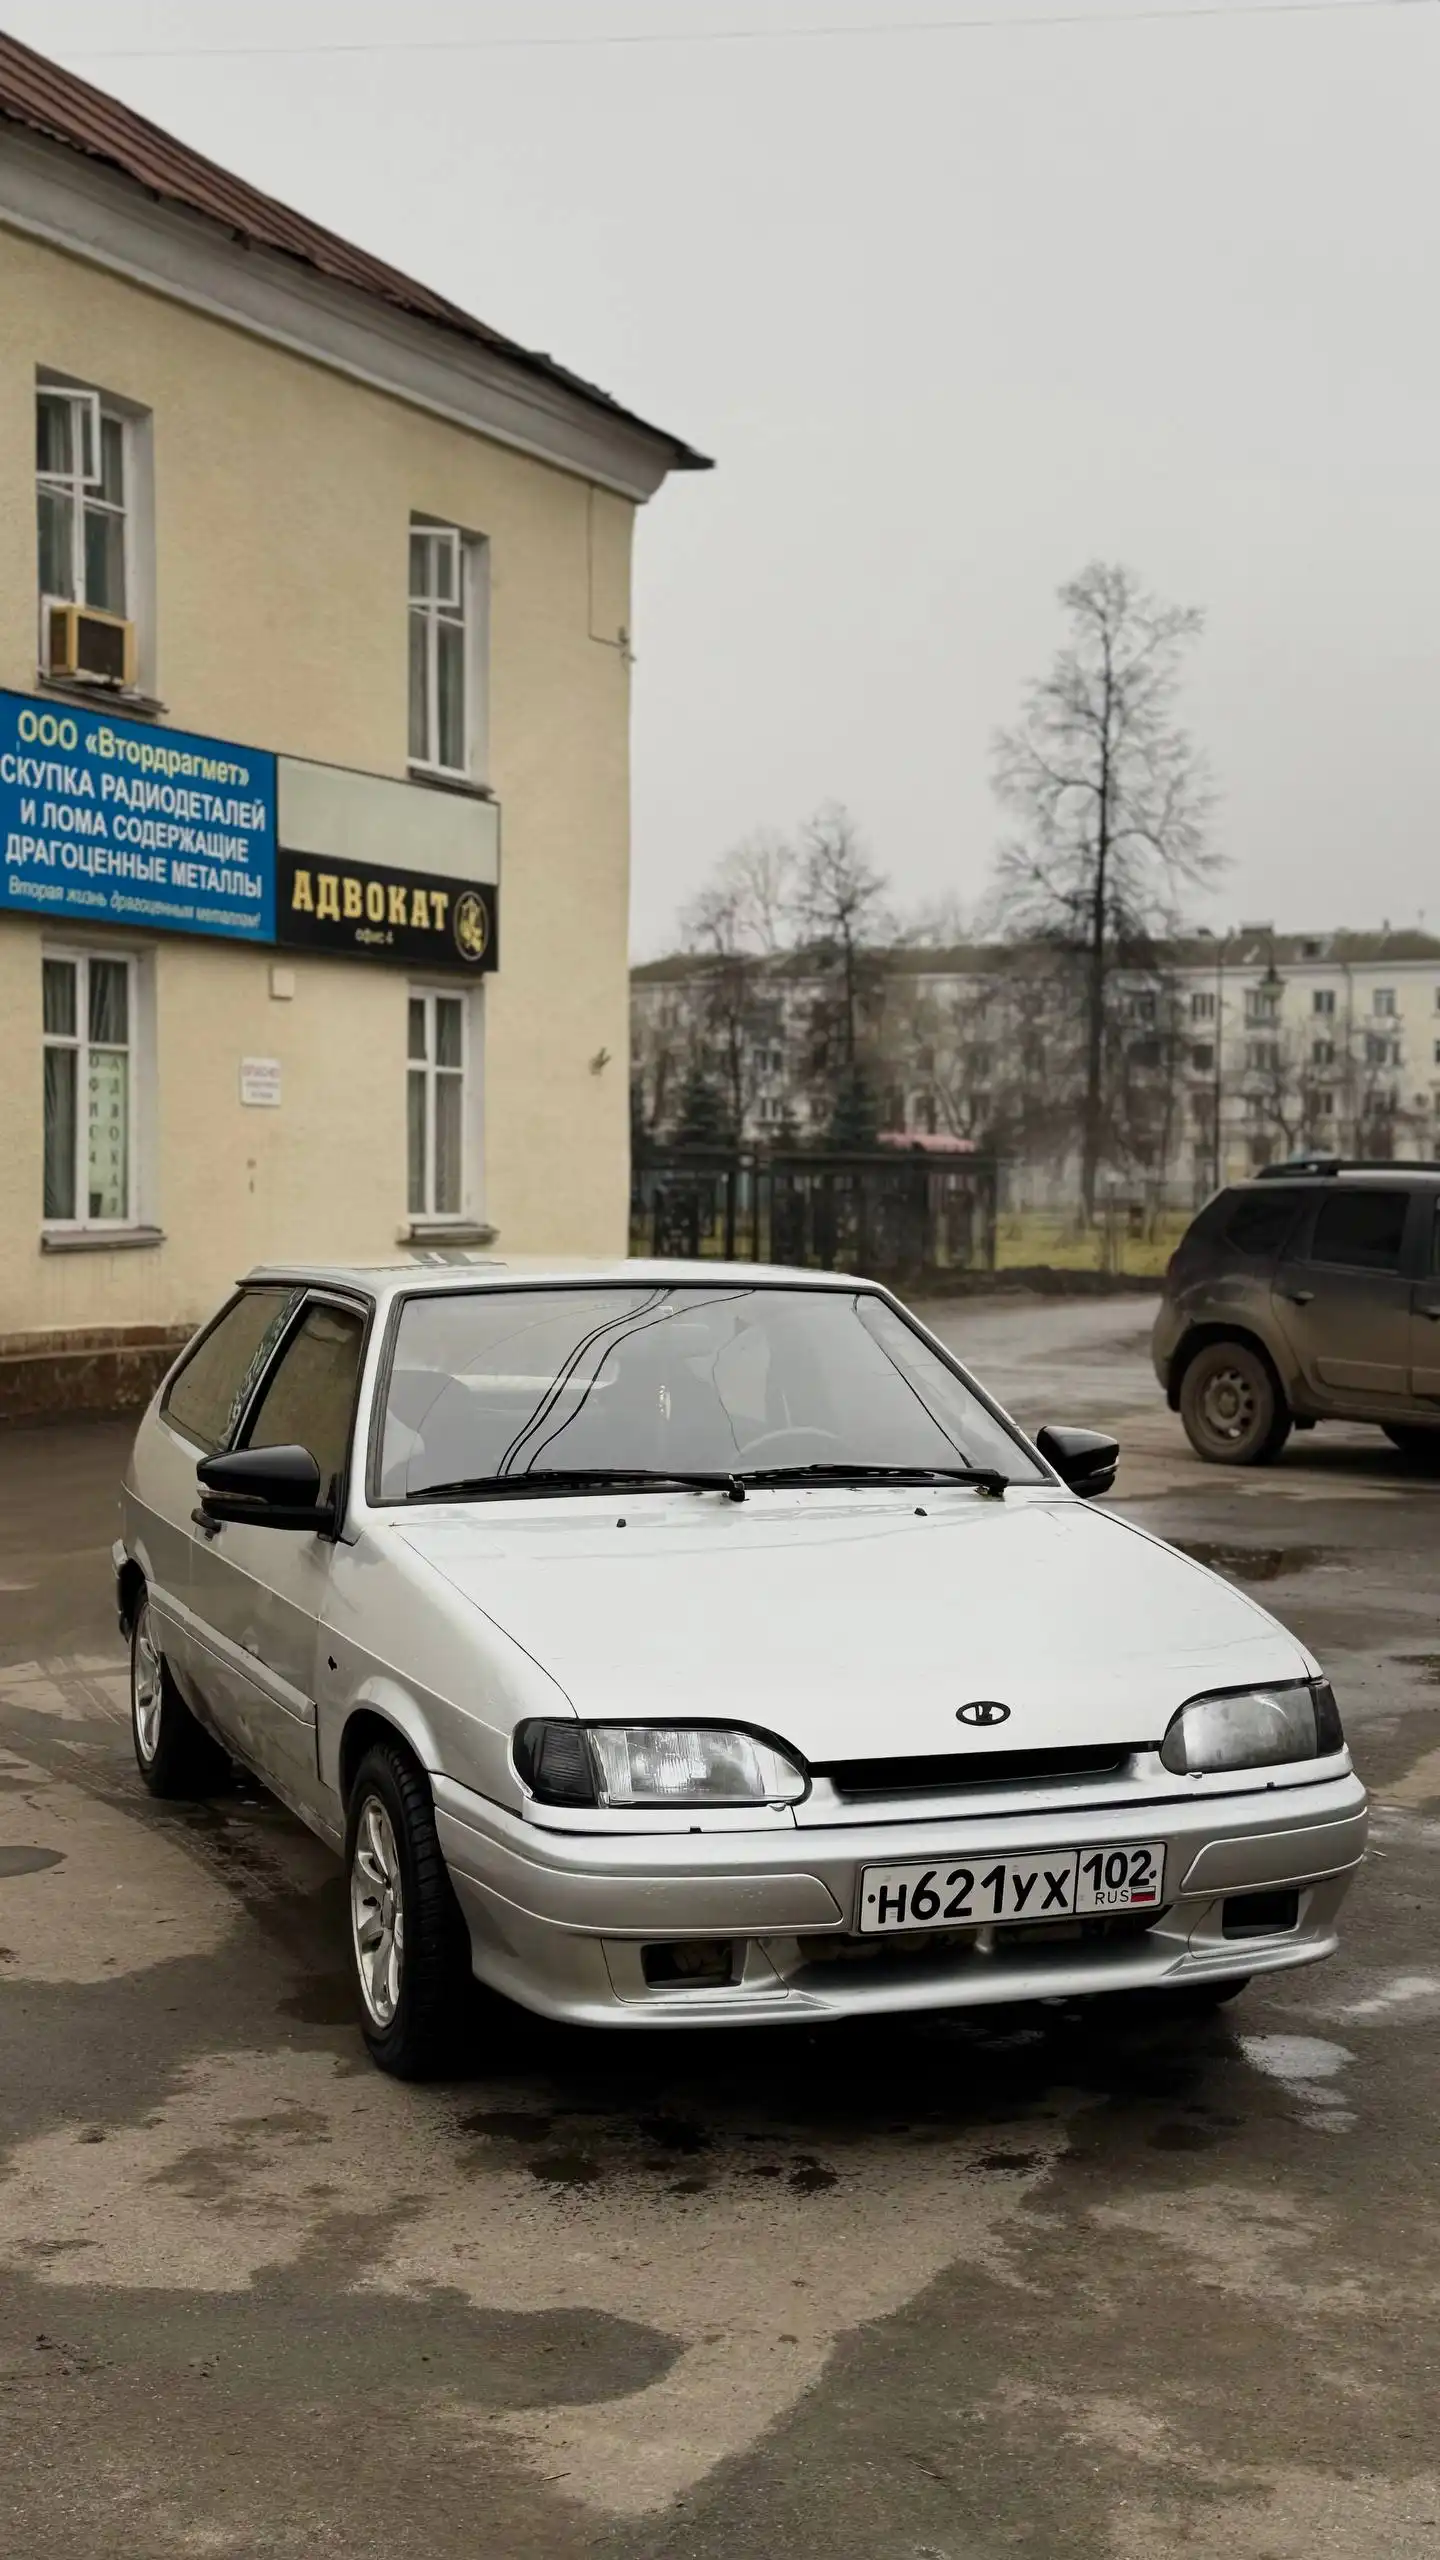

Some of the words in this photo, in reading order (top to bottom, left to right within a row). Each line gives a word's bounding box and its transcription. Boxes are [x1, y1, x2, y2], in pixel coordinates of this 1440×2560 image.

[18, 709, 78, 751] ООО
[85, 726, 249, 786] «Втордрагмет»
[1, 753, 95, 799] СКУПКА
[101, 772, 266, 831] РАДИОДЕТАЛЕЙ
[21, 798, 36, 826] И
[42, 802, 108, 838] ЛОМА
[113, 815, 249, 863] СОДЕРЖАЩИЕ
[5, 833, 167, 884] ДРАГОЦЕННЫЕ
[171, 860, 262, 898] МЕТАЛЛЫ
[292, 869, 448, 931] АДВОКАТ
[878, 1865, 1071, 1924] Н621УХ
[1083, 1849, 1152, 1891] 102
[1094, 1889, 1130, 1905] RUS
